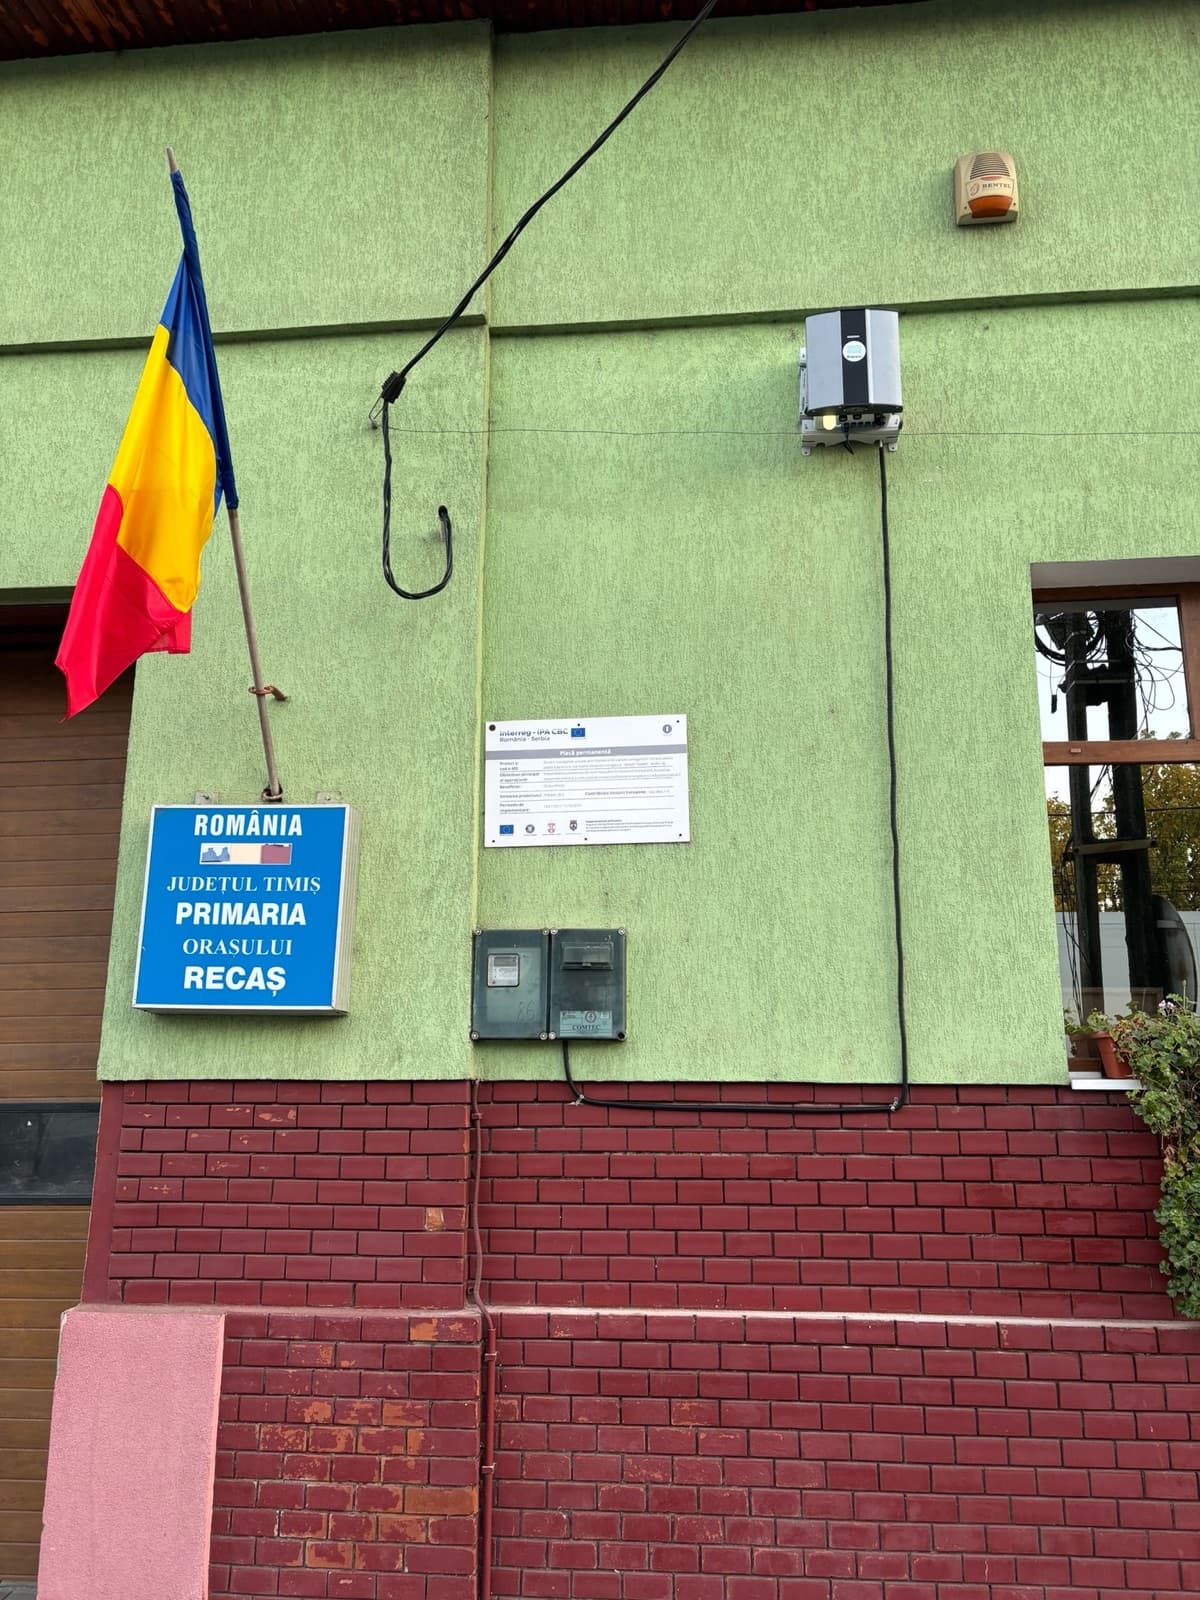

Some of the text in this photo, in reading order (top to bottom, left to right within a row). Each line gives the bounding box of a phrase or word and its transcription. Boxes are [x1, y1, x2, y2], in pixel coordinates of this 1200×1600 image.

[194, 810, 303, 836] ROMÂNIA
[167, 877, 320, 895] JUDEȚUL TIMIȘ
[176, 902, 306, 925] PRIMARIA
[184, 966, 286, 997] RECAȘ
